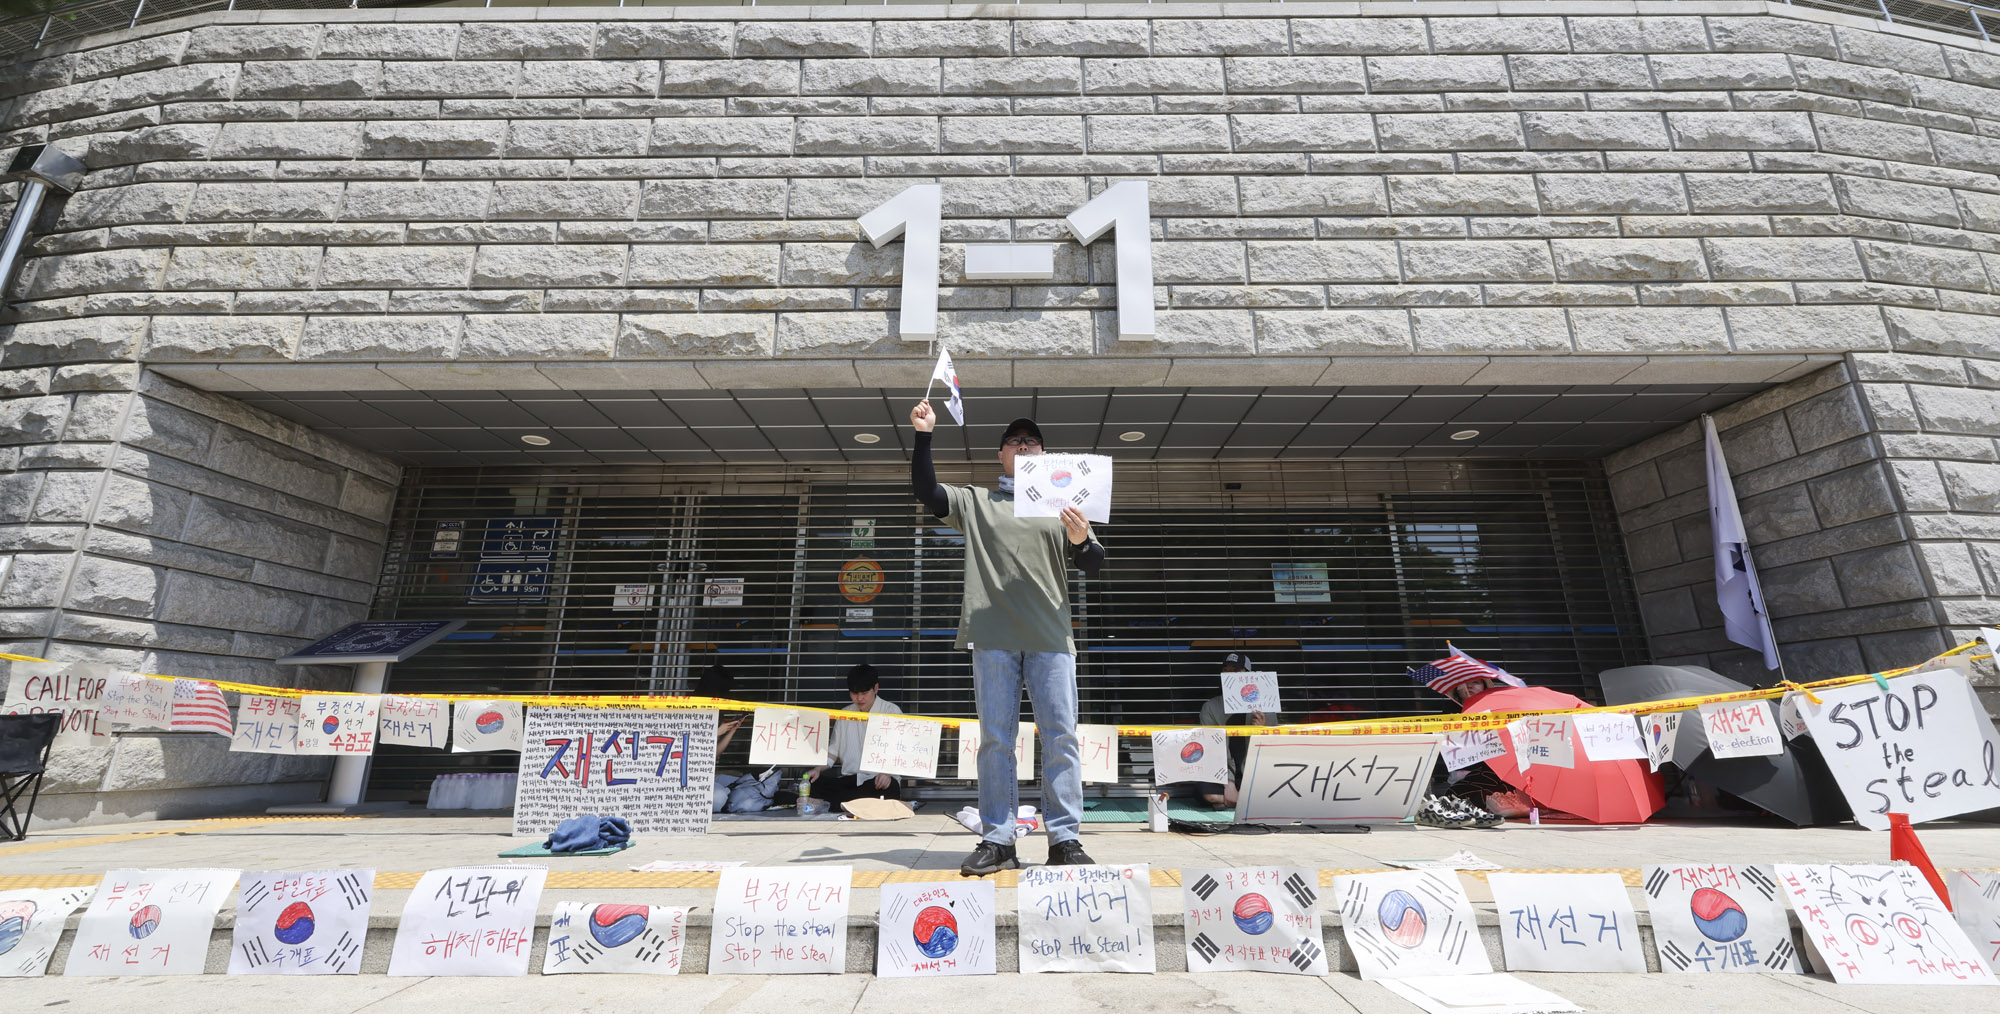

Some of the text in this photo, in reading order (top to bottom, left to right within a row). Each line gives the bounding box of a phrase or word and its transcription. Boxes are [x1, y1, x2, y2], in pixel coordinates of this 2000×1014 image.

[857, 180, 1155, 341] 1-1
[24, 675, 107, 701] CALL FOR
[383, 719, 433, 747] 재선거
[1708, 704, 1765, 734] 재선거
[1828, 684, 1938, 751] STOP
[755, 716, 821, 754] 재선거
[540, 731, 690, 788] 재선거
[1882, 742, 1915, 769] the
[1268, 755, 1422, 805] 재선거
[434, 874, 528, 919] 선관위
[744, 878, 841, 912] 부정선거
[1036, 885, 1130, 924] 재선거
[773, 917, 798, 937] the
[1509, 904, 1622, 951] 재선거
[87, 943, 170, 966] 재선거
[771, 944, 794, 962] the
[1069, 935, 1095, 955] the
[1694, 939, 1760, 972] 수개표
